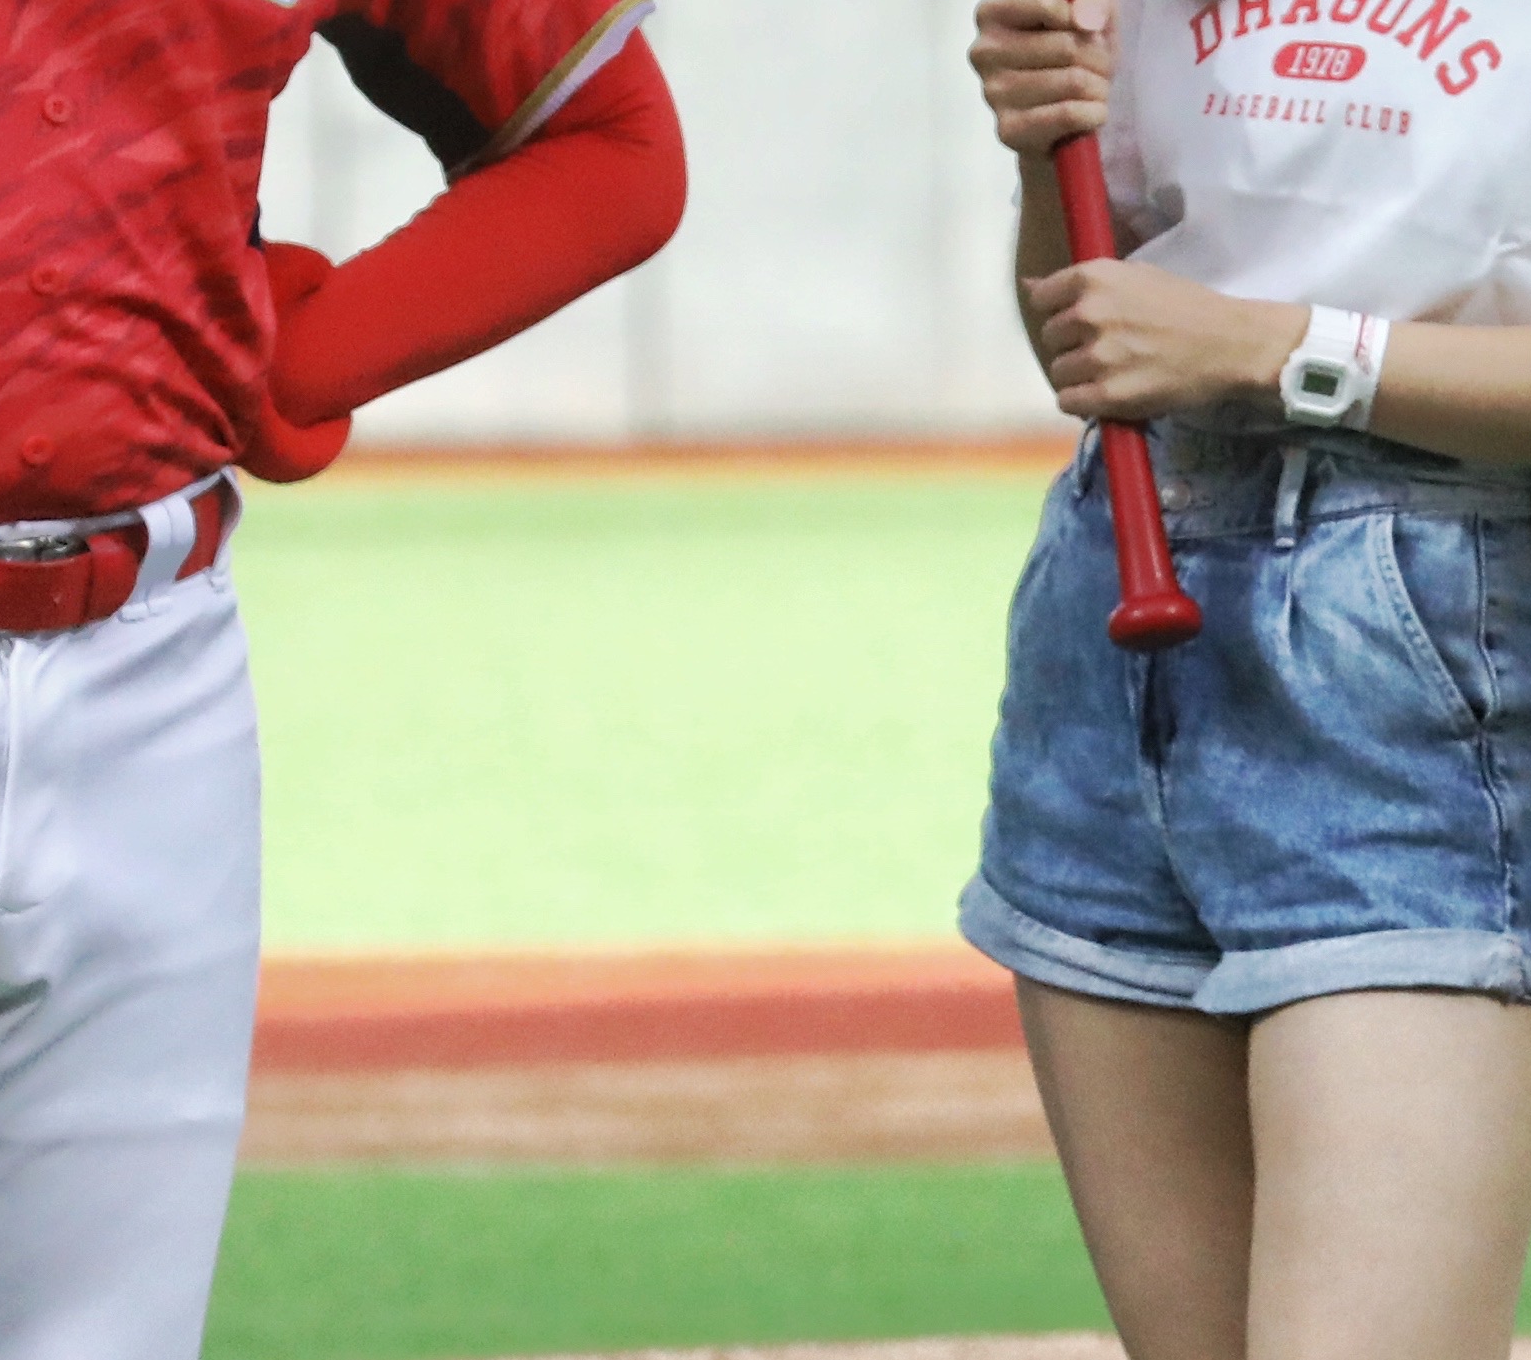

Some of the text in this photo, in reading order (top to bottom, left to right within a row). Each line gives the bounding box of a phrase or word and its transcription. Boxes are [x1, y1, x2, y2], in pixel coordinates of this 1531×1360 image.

[1288, 46, 1353, 77] 1978
[1203, 93, 1411, 136] BASEBALL CLUB
